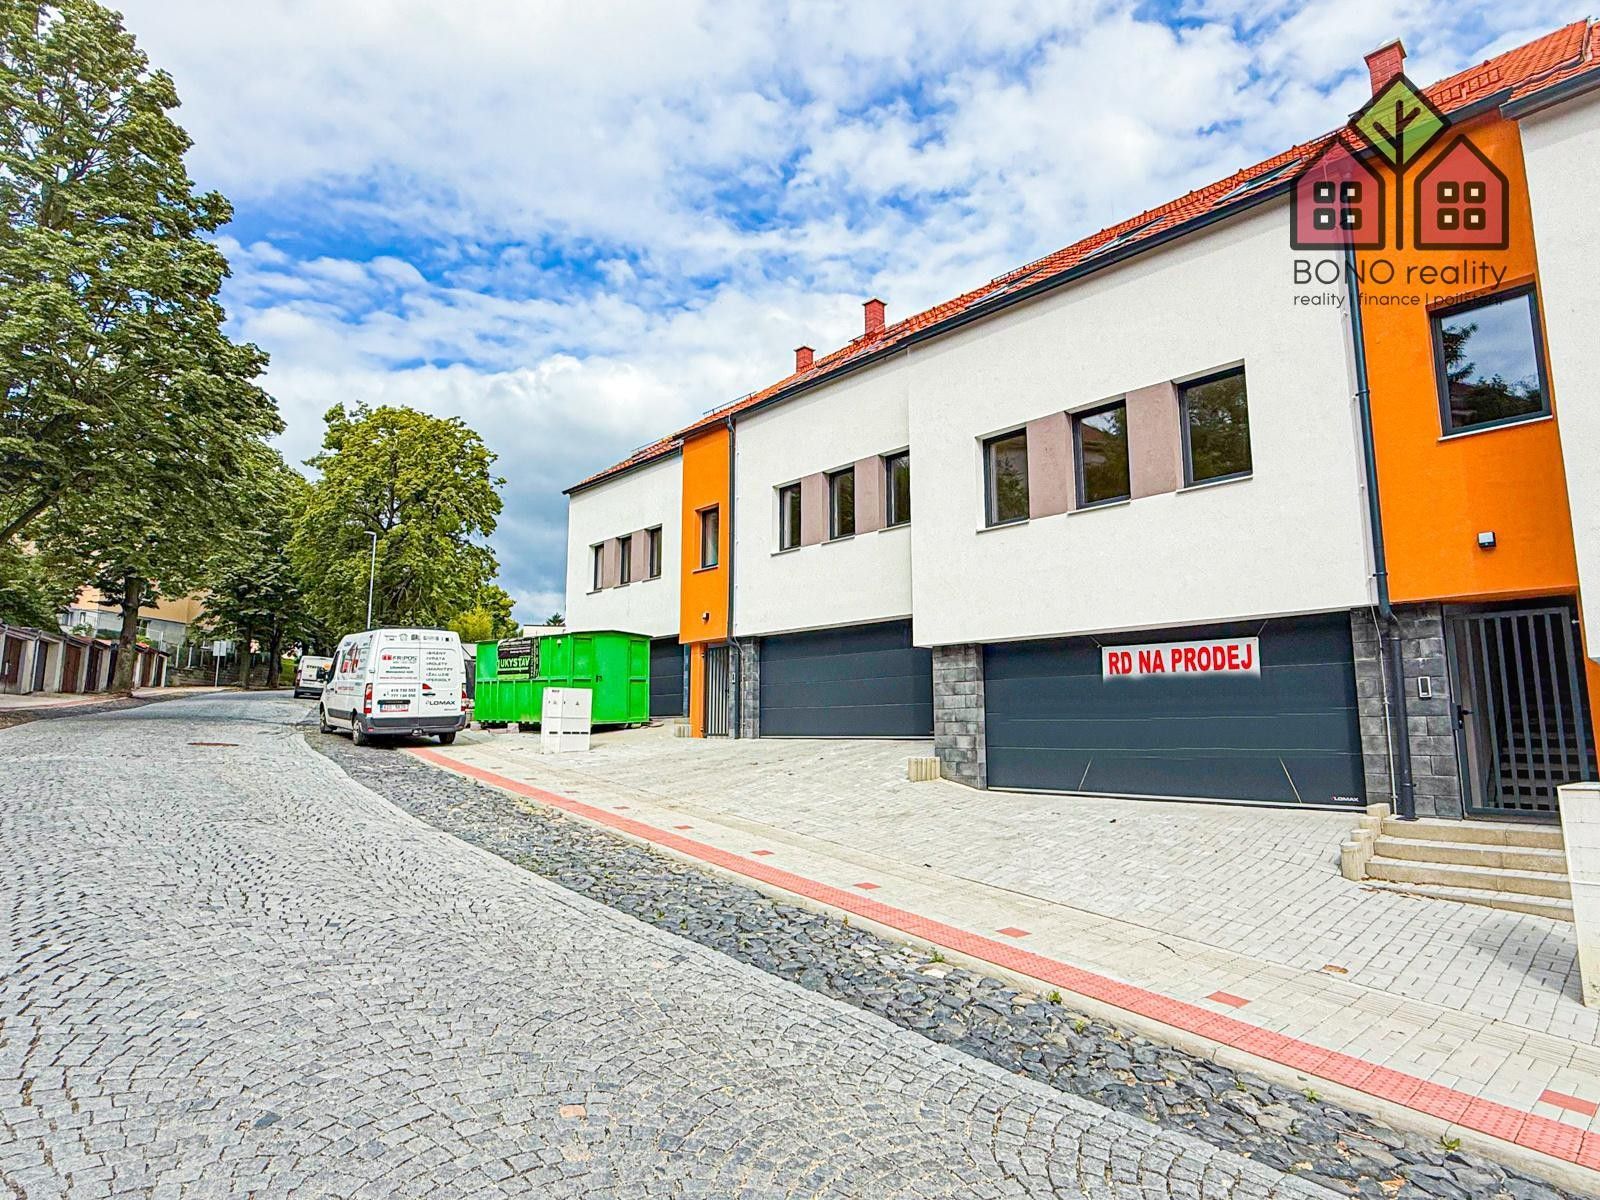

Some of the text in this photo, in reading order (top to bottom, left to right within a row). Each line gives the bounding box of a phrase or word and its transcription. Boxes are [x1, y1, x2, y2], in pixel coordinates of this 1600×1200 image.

[1108, 643, 1253, 675] RD NA PRODEJ
